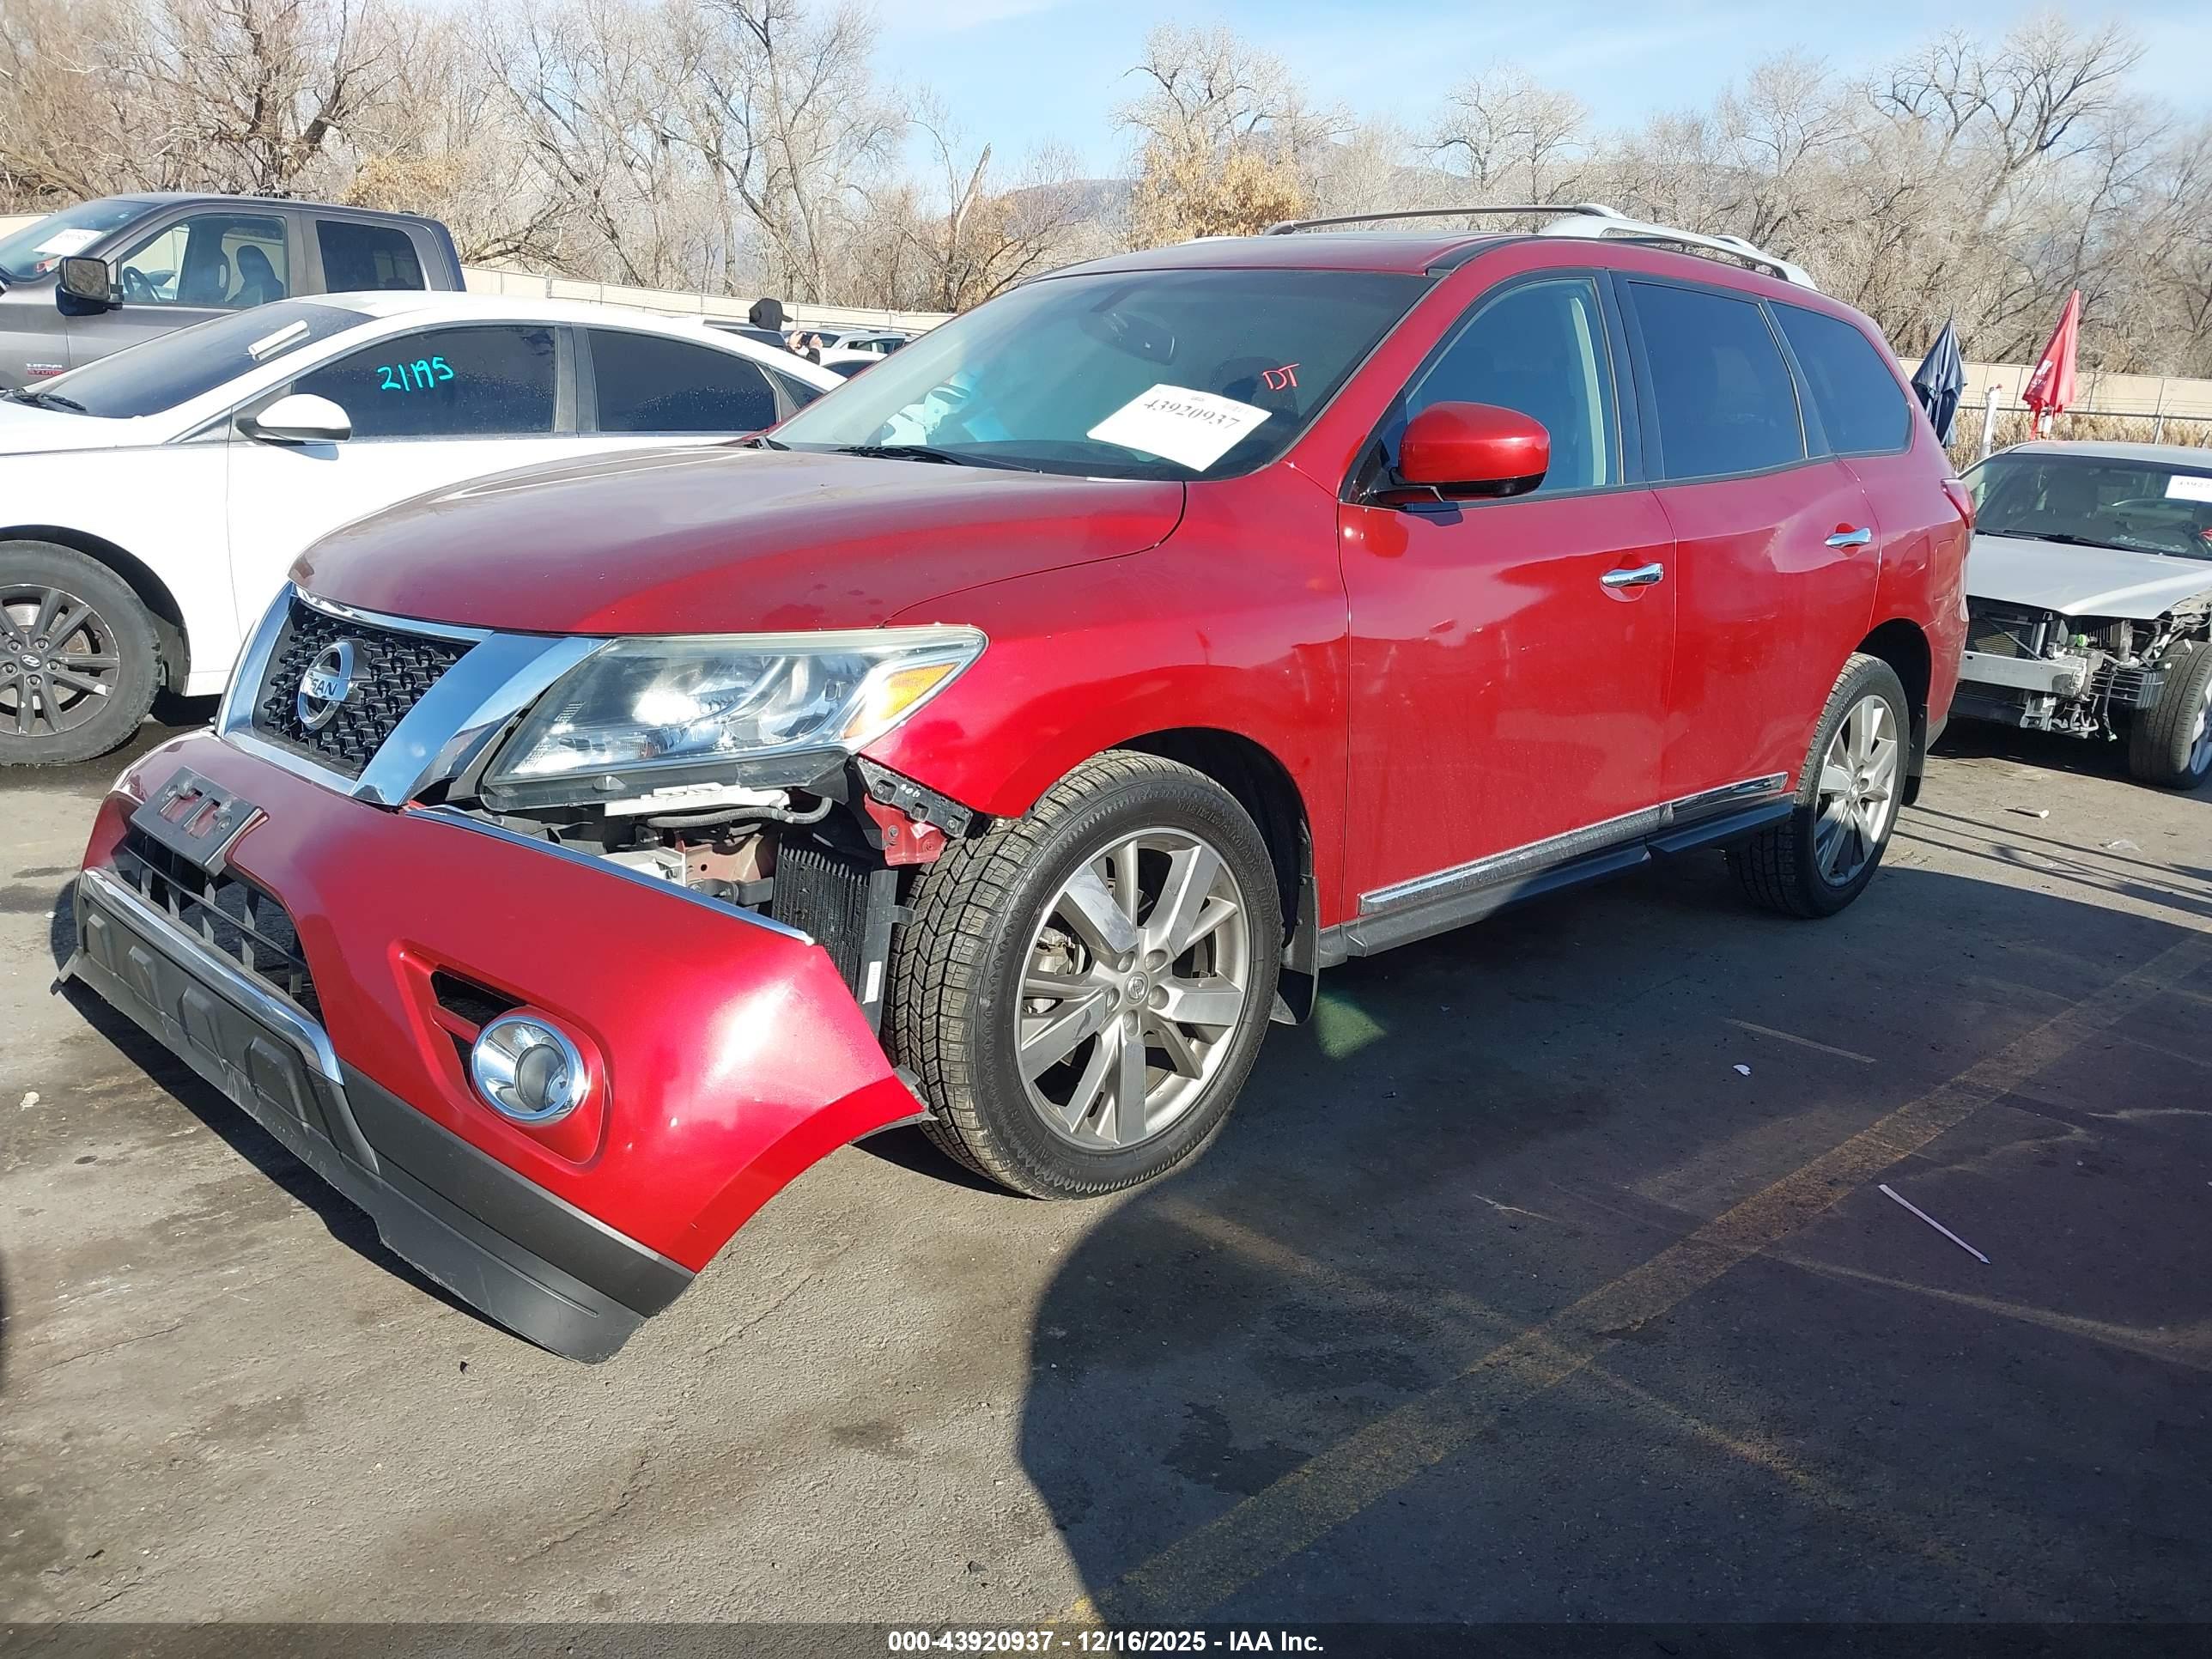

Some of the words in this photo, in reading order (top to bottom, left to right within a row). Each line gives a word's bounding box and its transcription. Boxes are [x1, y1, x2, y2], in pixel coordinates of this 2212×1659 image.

[377, 356, 454, 392] 2195
[1261, 362, 1301, 392] DT
[1144, 398, 1241, 429] 43920937
